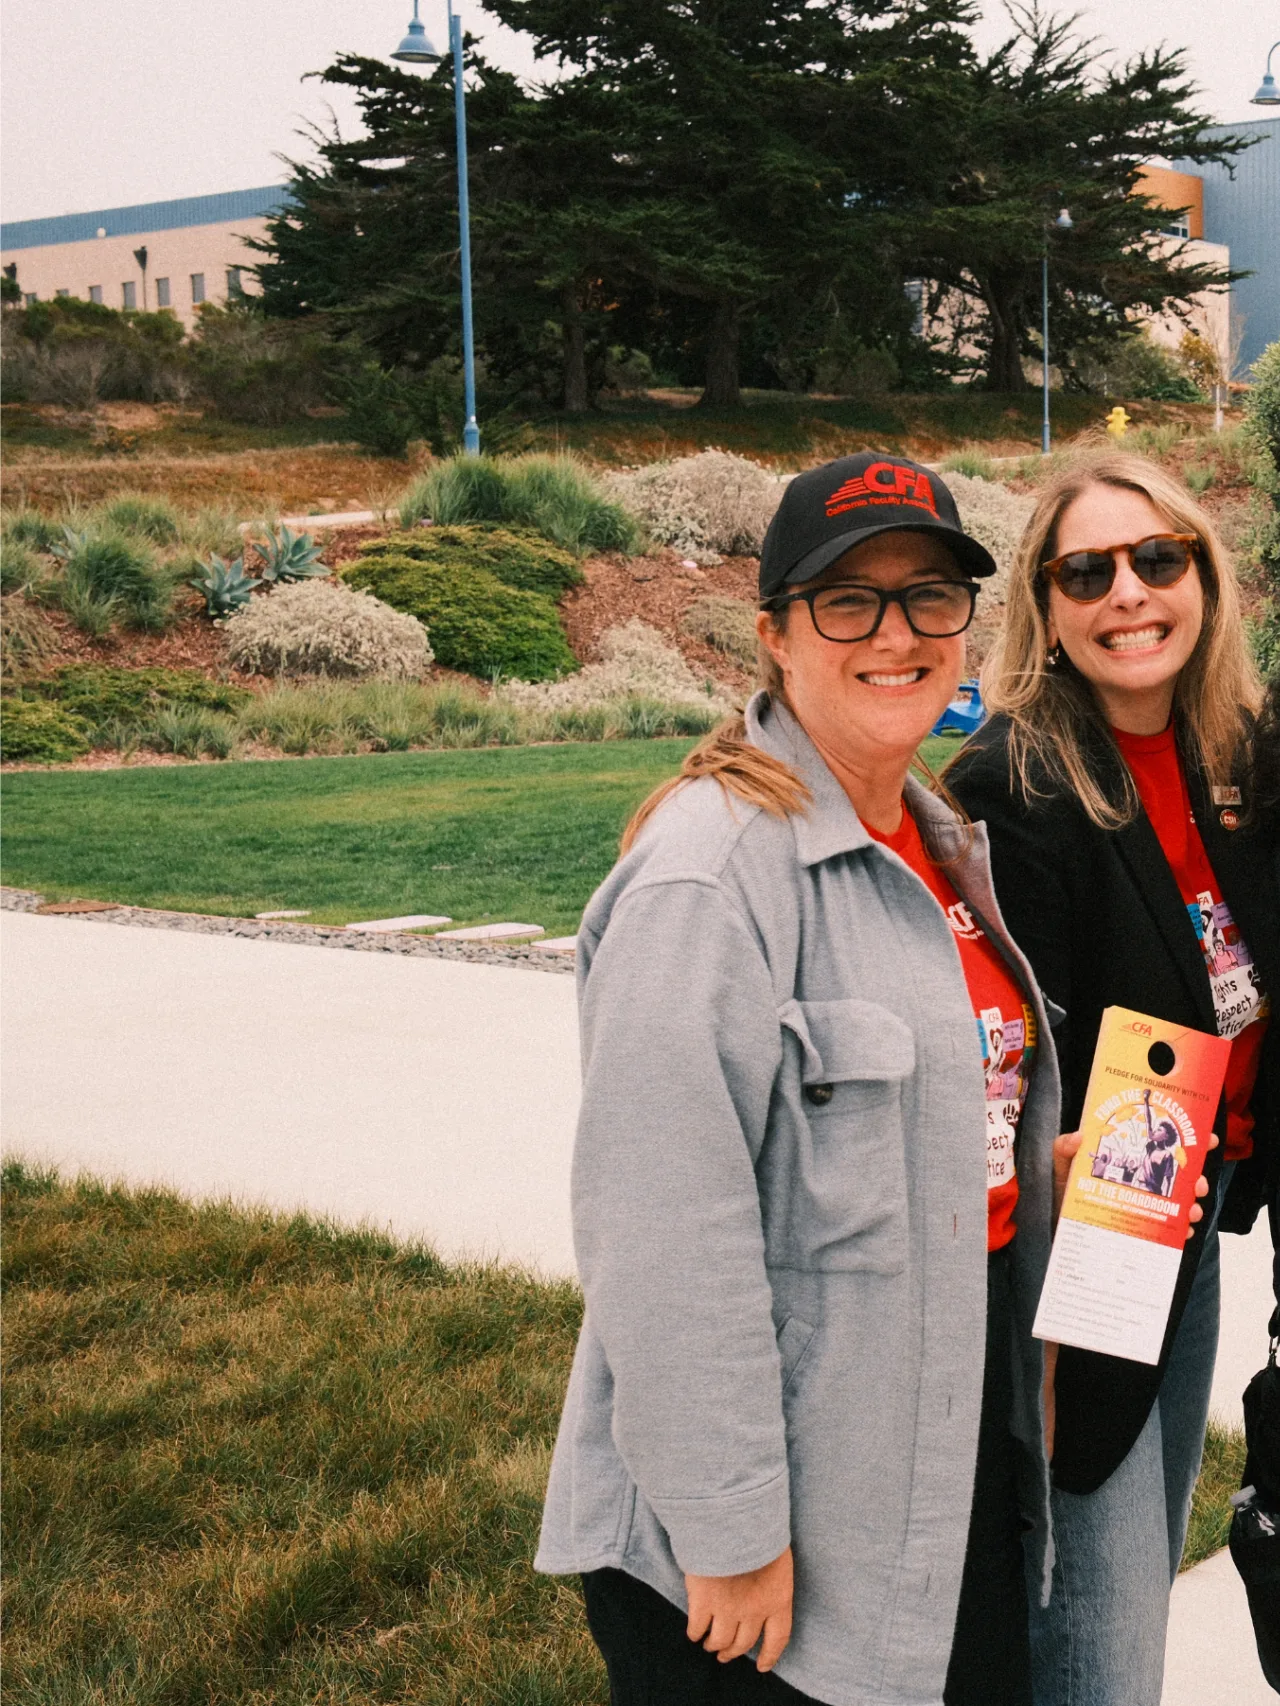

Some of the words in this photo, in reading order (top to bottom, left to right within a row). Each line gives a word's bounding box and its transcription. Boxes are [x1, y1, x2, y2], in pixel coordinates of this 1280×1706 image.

[863, 461, 937, 511] CFA
[826, 499, 869, 517] California
[869, 496, 901, 506] Faculty
[1214, 994, 1252, 1023] Respect
[1131, 1021, 1153, 1036] CFA
[1104, 1066, 1130, 1079] PLEDGE
[1130, 1073, 1143, 1083] FOR
[1144, 1077, 1181, 1094] SOLIDARITY
[1181, 1087, 1198, 1099] WITH
[1120, 1088, 1142, 1103] THE
[1152, 1090, 1198, 1147] CLASSROOM
[1077, 1177, 1099, 1194] NOT
[1099, 1183, 1118, 1200] THE
[1118, 1188, 1180, 1218] BOARDROOM
